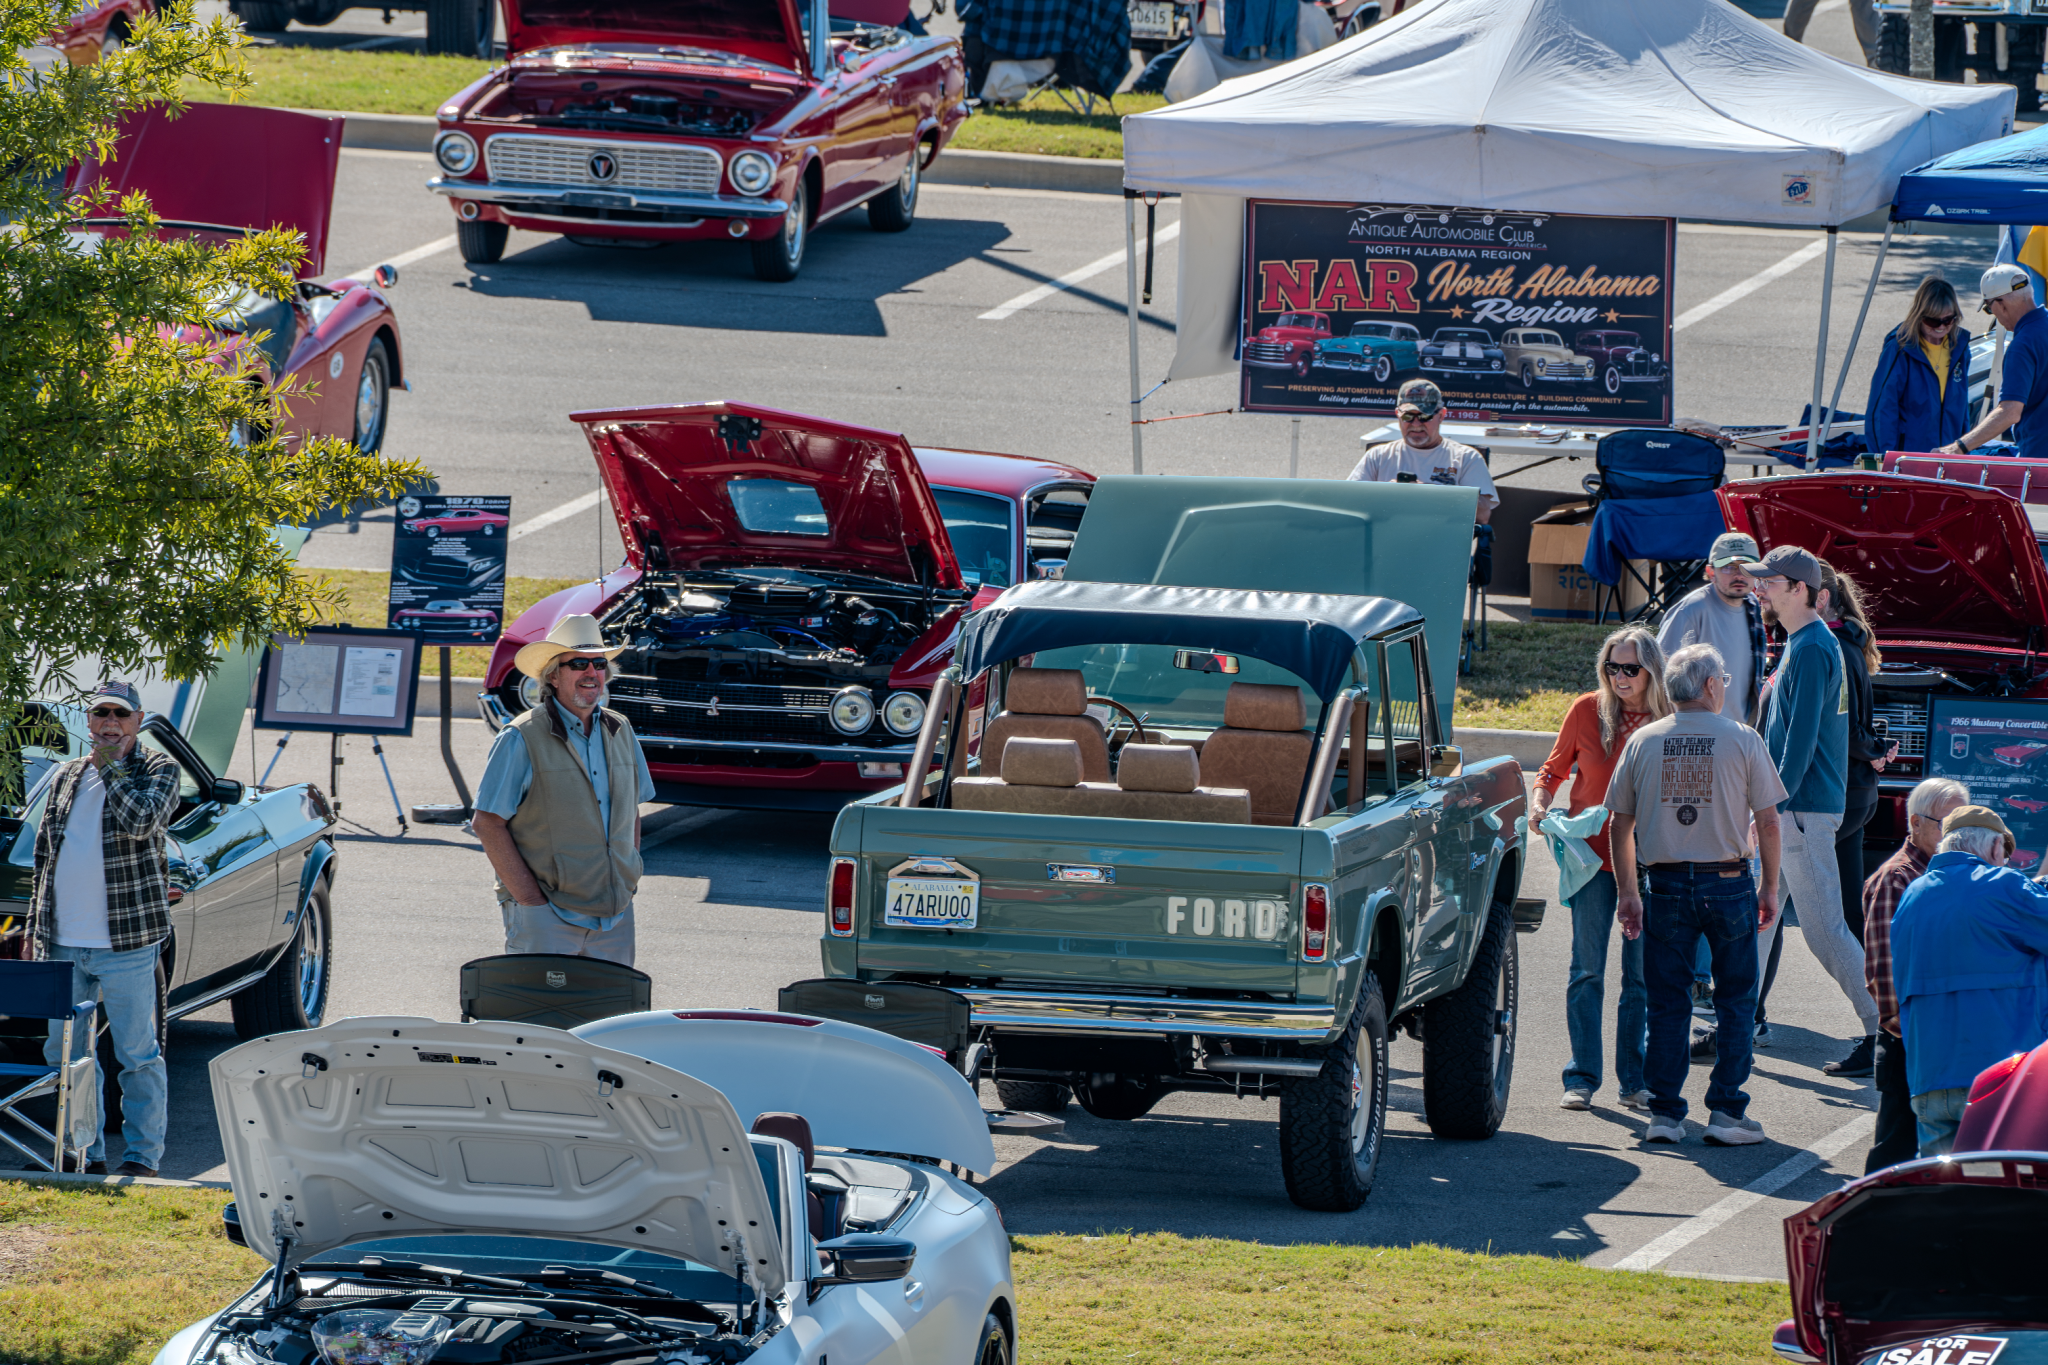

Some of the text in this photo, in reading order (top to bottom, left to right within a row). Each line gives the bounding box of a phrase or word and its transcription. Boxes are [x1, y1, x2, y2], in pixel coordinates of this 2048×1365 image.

[1348, 220, 1535, 243] ANTIQUE AUTOMOBILE CLUB
[1365, 245, 1532, 261] NORTH ALABAMA REGION
[1258, 258, 1420, 314] NAR
[1427, 259, 1661, 302] North Alabama
[1471, 297, 1598, 327] Region
[1288, 384, 1335, 394] PRESERVING
[1336, 386, 1385, 395] AUTOMOTIVE
[1386, 388, 1399, 396] HIS
[1440, 390, 1474, 399] OMOTING
[1492, 393, 1527, 401] CULTURE
[1538, 394, 1574, 403] BUILDING
[1575, 396, 1622, 404] COMMUNITY
[1319, 394, 1349, 405] Uniting
[1351, 396, 1396, 405] enthusiasts
[1447, 400, 1479, 409] timeless
[1479, 401, 1511, 410] passion
[1512, 401, 1526, 411] for
[1528, 402, 1542, 410] the
[1543, 403, 1590, 412] automobile.
[1458, 411, 1480, 419] 1962
[1951, 717, 2048, 729] 1966 Mustang Convertible
[1685, 737, 1716, 745] DELMORE
[1663, 744, 1714, 756] BROTHERS.
[1681, 756, 1698, 764] REALLY
[1661, 770, 1713, 783] INFLUENCED
[1684, 796, 1701, 804] DYLAN
[911, 883, 955, 892] ALABAMA
[1167, 896, 1277, 939] FORD
[1368, 1036, 1384, 1155] BFGoodrich
[1922, 1337, 1969, 1350] FOR
[1883, 1348, 1992, 1365] SALE
